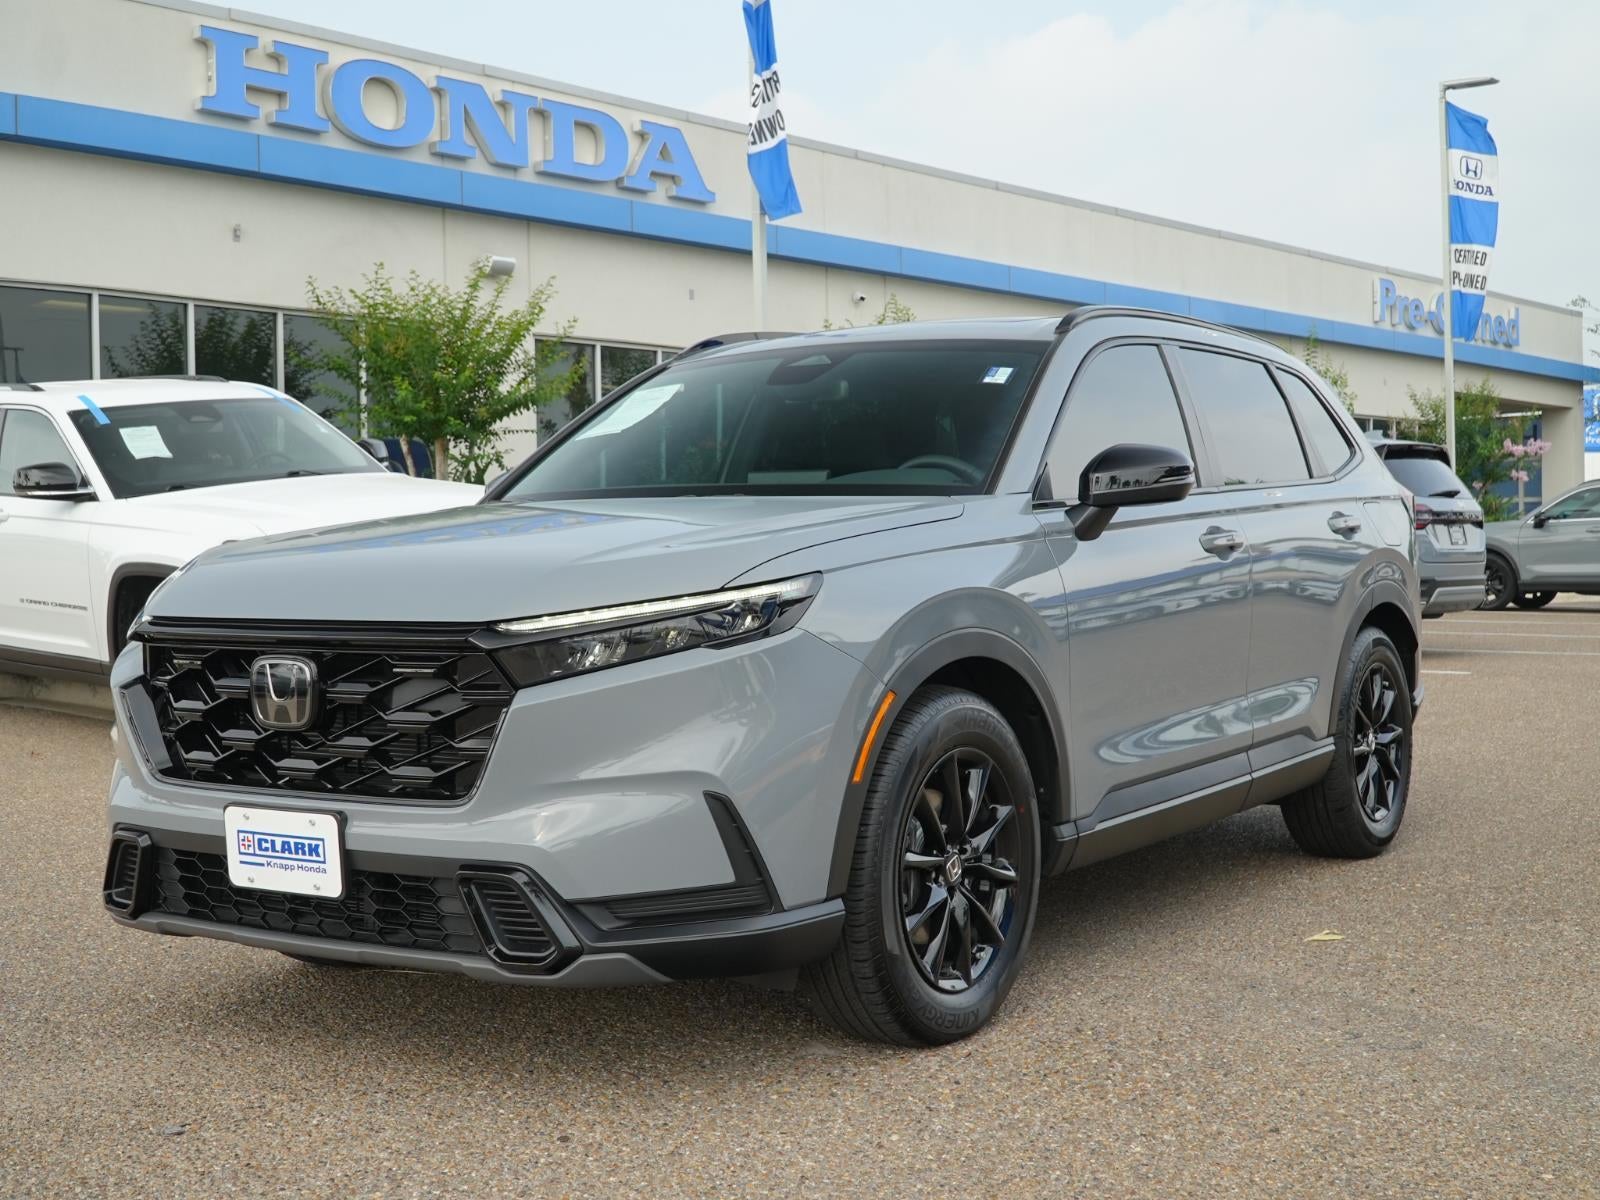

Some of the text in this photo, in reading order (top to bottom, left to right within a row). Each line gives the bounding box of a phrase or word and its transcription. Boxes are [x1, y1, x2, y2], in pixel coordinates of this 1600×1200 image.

[196, 25, 716, 203] HONDA
[1374, 278, 1520, 347] Pre-ned
[257, 837, 321, 858] CLARK
[266, 860, 327, 874] Knapp Honda
